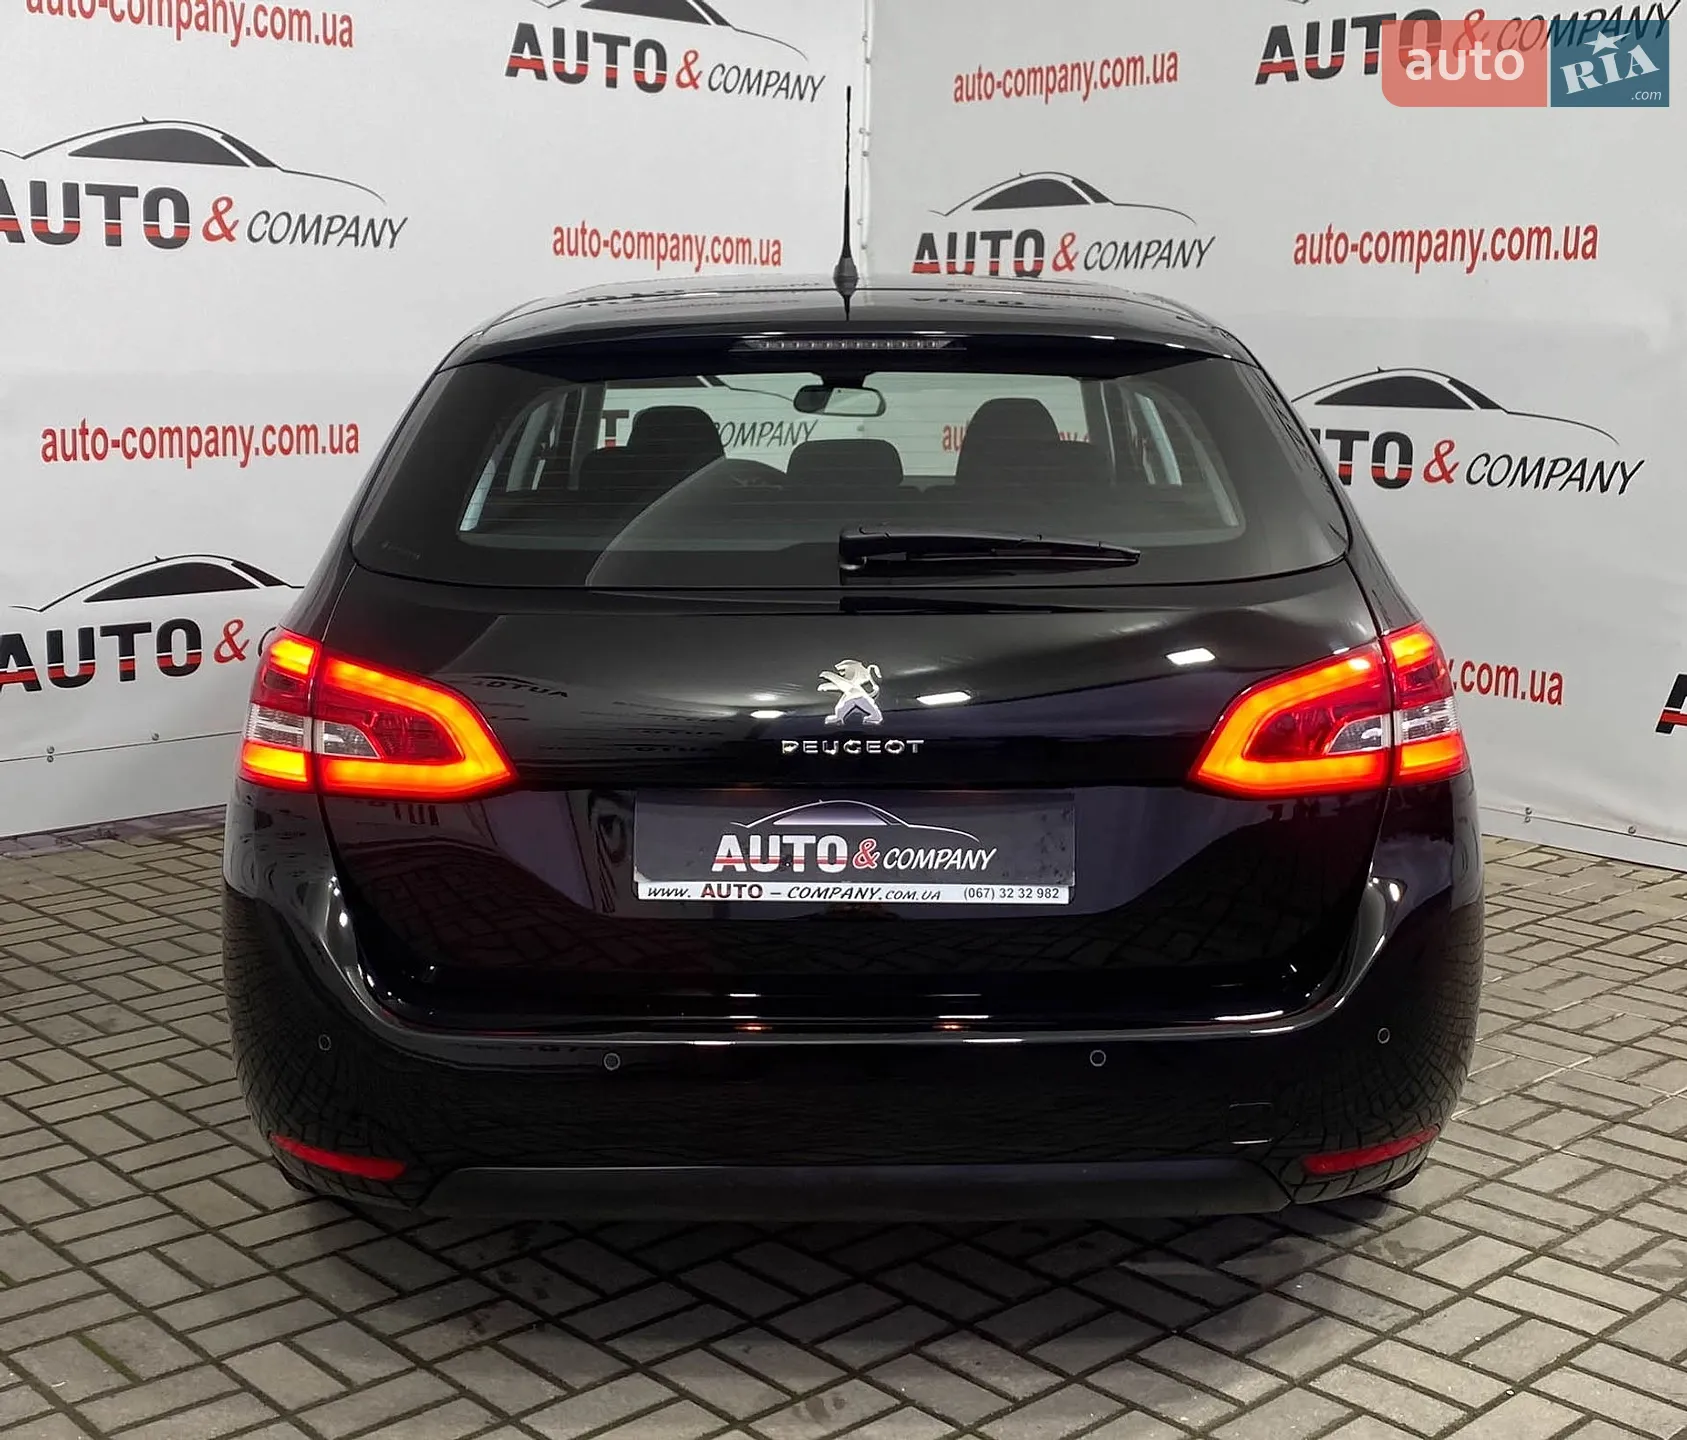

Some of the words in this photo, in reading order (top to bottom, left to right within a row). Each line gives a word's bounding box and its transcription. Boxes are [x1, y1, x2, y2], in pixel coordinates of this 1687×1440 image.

[505, 22, 667, 93] AUTO
[675, 49, 701, 90] &
[707, 63, 826, 103] COMPANY
[1255, 9, 1442, 85] AUTO
[1496, 0, 1682, 52] COMPANY
[953, 51, 1179, 104] auto-company.com.ua
[203, 197, 239, 243] &
[246, 210, 408, 250] COMPANY
[553, 219, 782, 273] auto-company.com.ua
[1293, 223, 1598, 273] auto-company.com.ua
[911, 229, 1045, 278] AUTO
[1052, 232, 1078, 272] &
[1084, 236, 1216, 271] COMPANY
[41, 418, 359, 468] auto-company.com.ua
[1423, 440, 1459, 485] &
[1465, 452, 1645, 495] COMPANY
[213, 618, 249, 663] &
[781, 739, 924, 755] PEUGEOT
[711, 834, 848, 872] AUTO
[853, 838, 880, 869] &
[883, 848, 996, 871] COMPANY
[701, 883, 763, 899] AUTO
[963, 887, 995, 901] (067)
[999, 888, 1014, 899] 32
[1018, 888, 1033, 899] 32
[1036, 888, 1059, 900] 982
